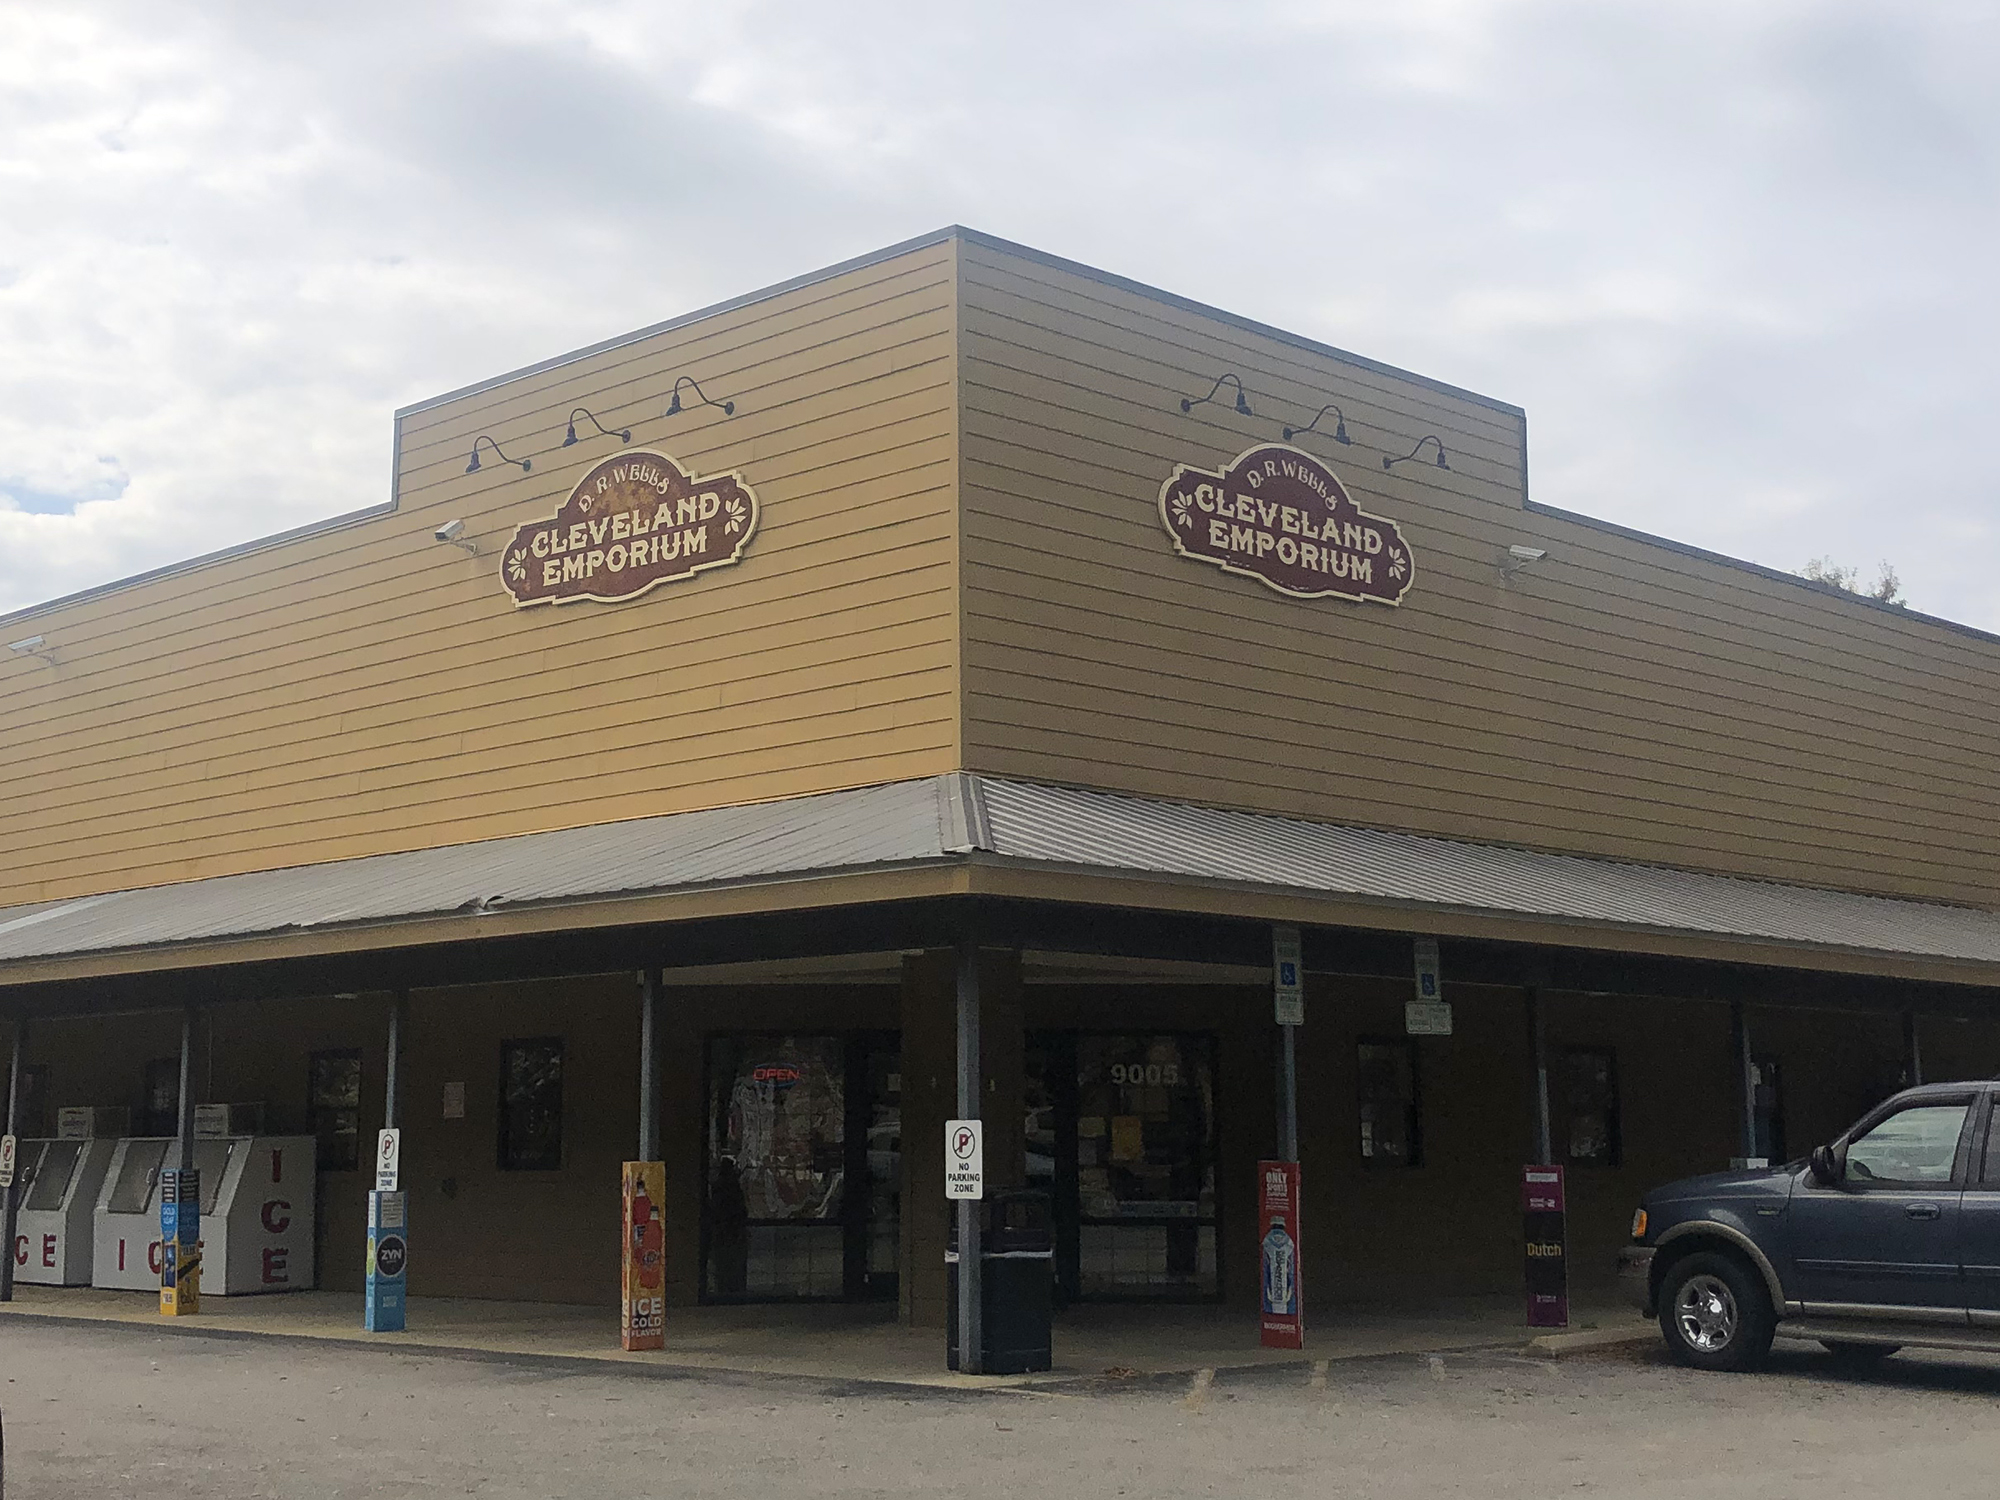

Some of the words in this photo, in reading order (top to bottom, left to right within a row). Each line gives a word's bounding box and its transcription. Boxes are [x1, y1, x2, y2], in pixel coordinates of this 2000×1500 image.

[531, 492, 720, 558] CLEVELAND
[1194, 483, 1383, 555] CLEVELAND
[542, 525, 708, 587] EMPORIUM
[1208, 518, 1373, 585] EMPORIUM
[753, 1068, 800, 1082] OPEN
[1110, 1063, 1179, 1087] 9005
[958, 1162, 970, 1171] NO
[948, 1173, 980, 1182] PARKING
[954, 1183, 975, 1193] ZONE
[381, 1249, 403, 1261] ZYN
[1526, 1242, 1562, 1257] Dutch
[631, 1297, 662, 1317] ICE
[631, 1316, 662, 1329] COLD
